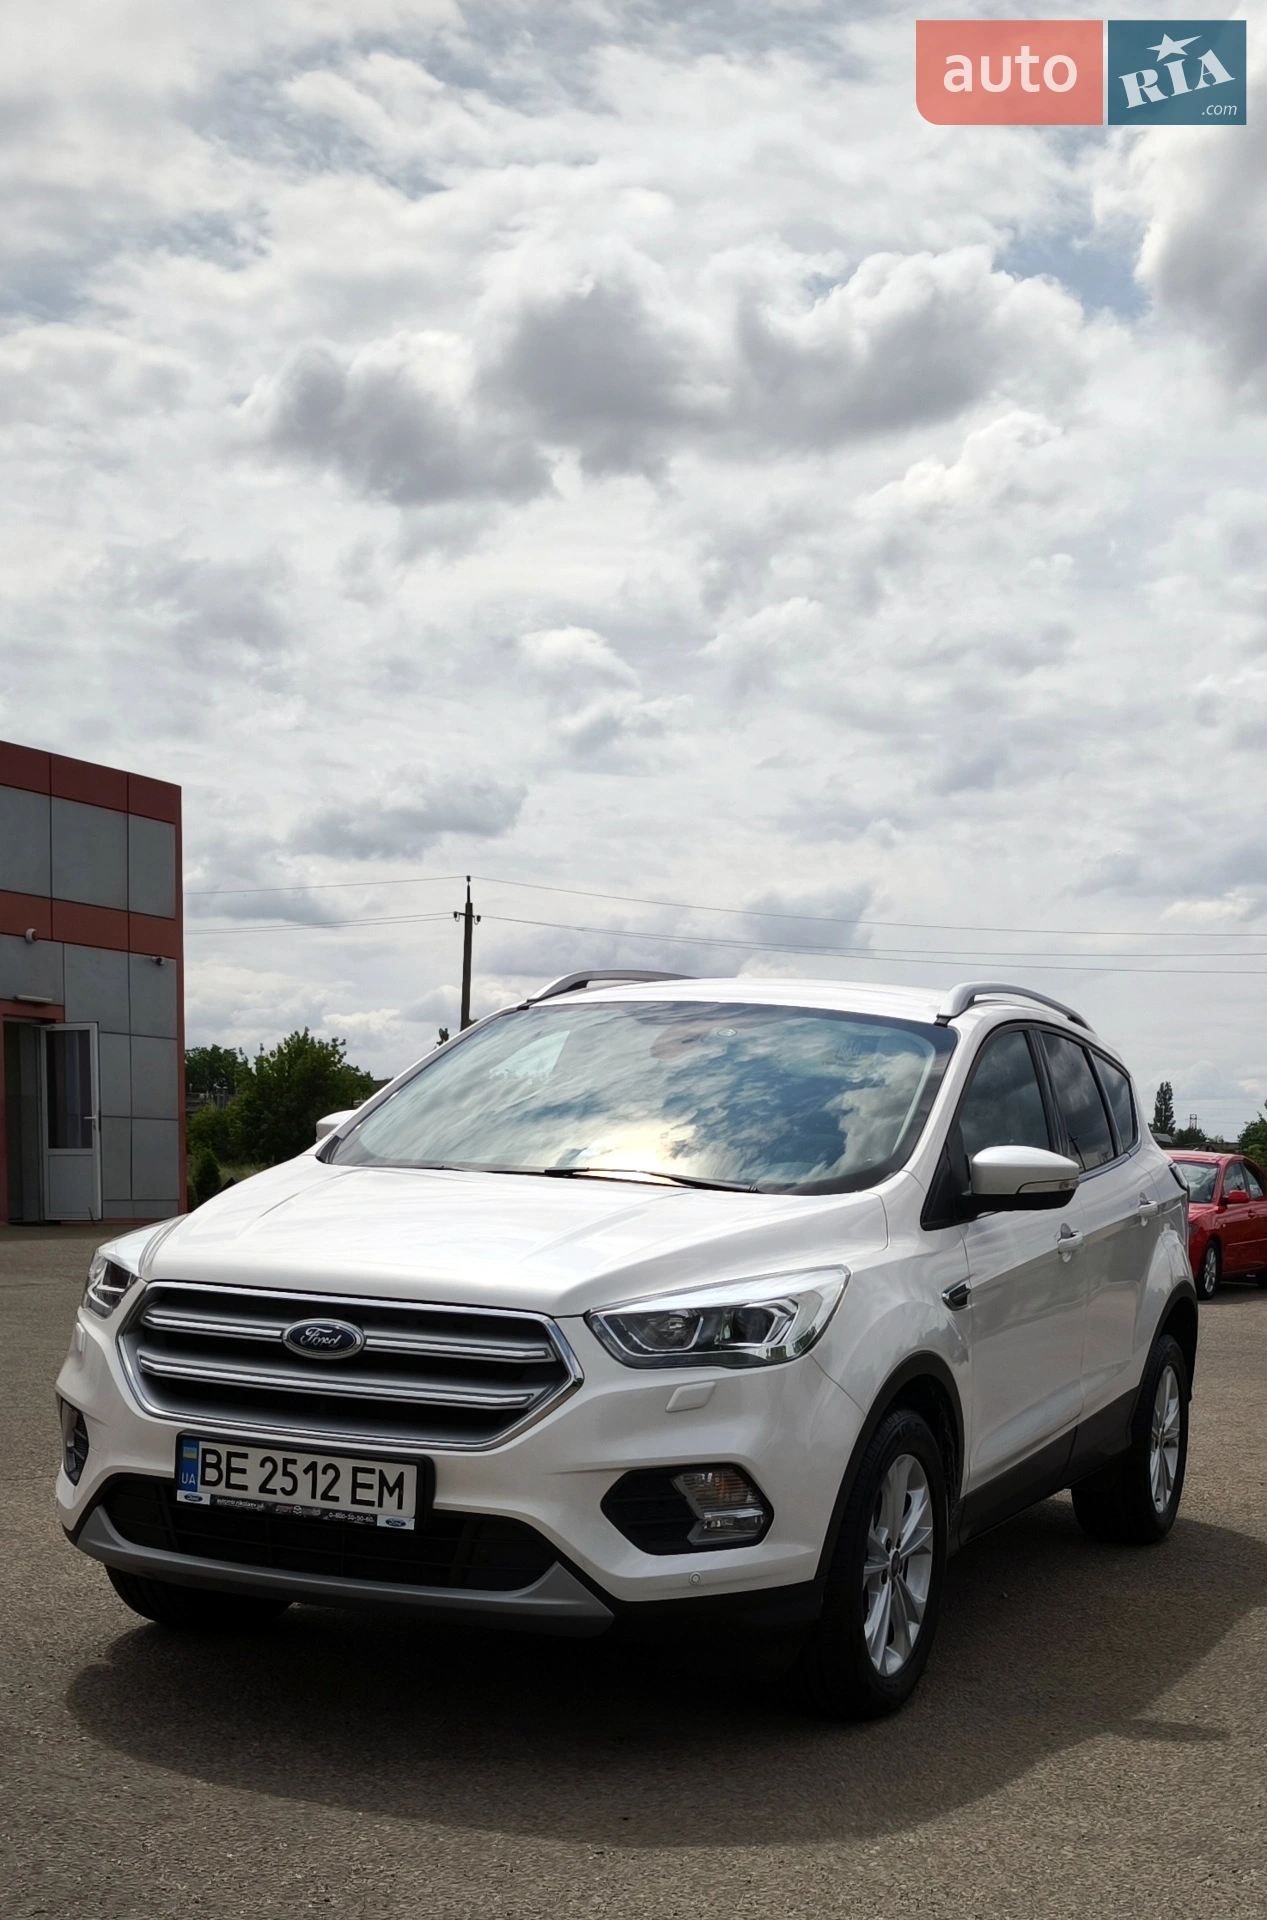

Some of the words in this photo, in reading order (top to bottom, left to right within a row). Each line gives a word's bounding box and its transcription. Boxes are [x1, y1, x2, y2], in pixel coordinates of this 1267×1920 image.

[300, 1326, 342, 1347] Ford
[181, 1472, 196, 1485] UA
[200, 1447, 249, 1491] BE
[258, 1455, 341, 1503] 2512
[351, 1466, 405, 1510] EM
